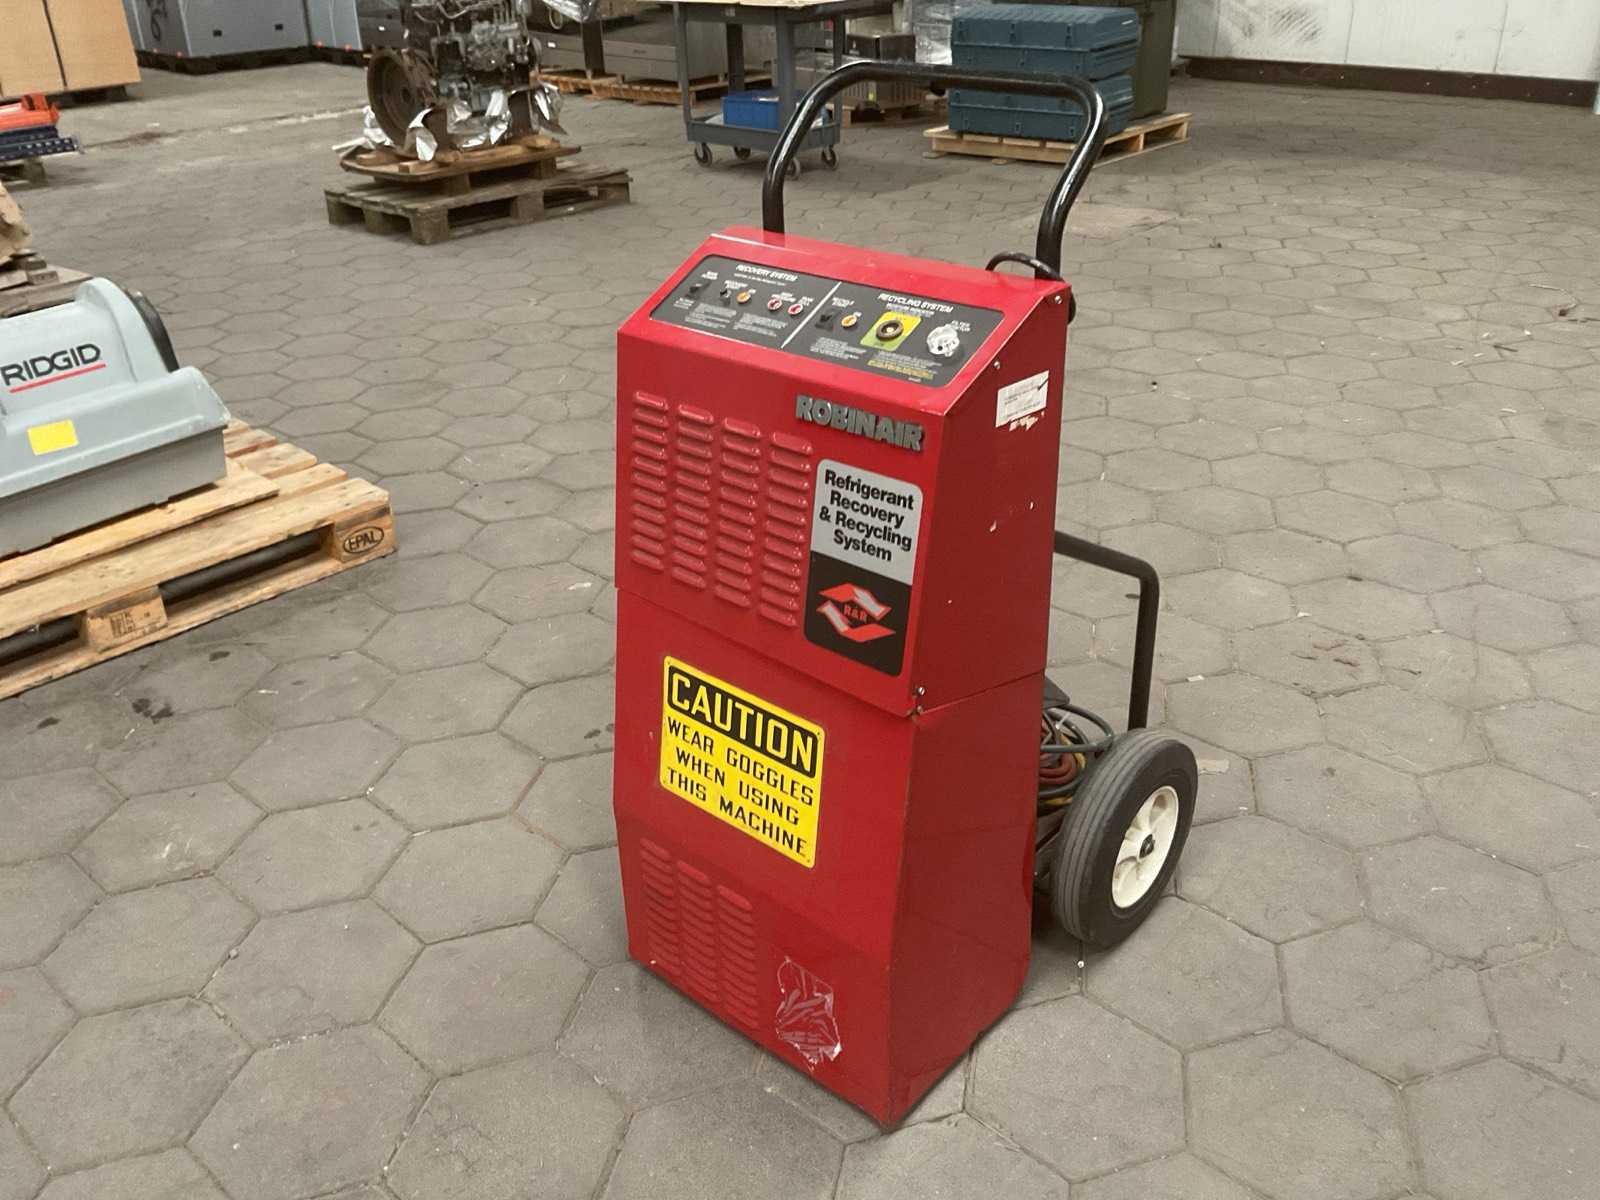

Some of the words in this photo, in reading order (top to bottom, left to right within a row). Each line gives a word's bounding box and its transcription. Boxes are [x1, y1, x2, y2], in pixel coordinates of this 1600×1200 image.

[736, 264, 770, 277] RECOVERY
[769, 270, 798, 282] SYSTEM
[878, 293, 921, 308] RECYCLING
[920, 301, 953, 313] SYSTEM
[0, 343, 101, 386] RIDGID
[796, 394, 924, 452] ROBINAIR
[824, 469, 914, 510] Refrigerant
[830, 490, 904, 529] Recovery
[349, 530, 378, 550] EPAL
[819, 506, 831, 523] &
[835, 511, 912, 551] Recycling
[834, 529, 892, 562] System
[672, 672, 813, 773] CAUTION
[667, 716, 714, 756] WEAR
[726, 748, 814, 806] GOGGLES
[676, 747, 726, 787] WHEN
[739, 780, 799, 826] USING
[667, 766, 707, 802] THIS
[720, 795, 808, 858] MACHINE
